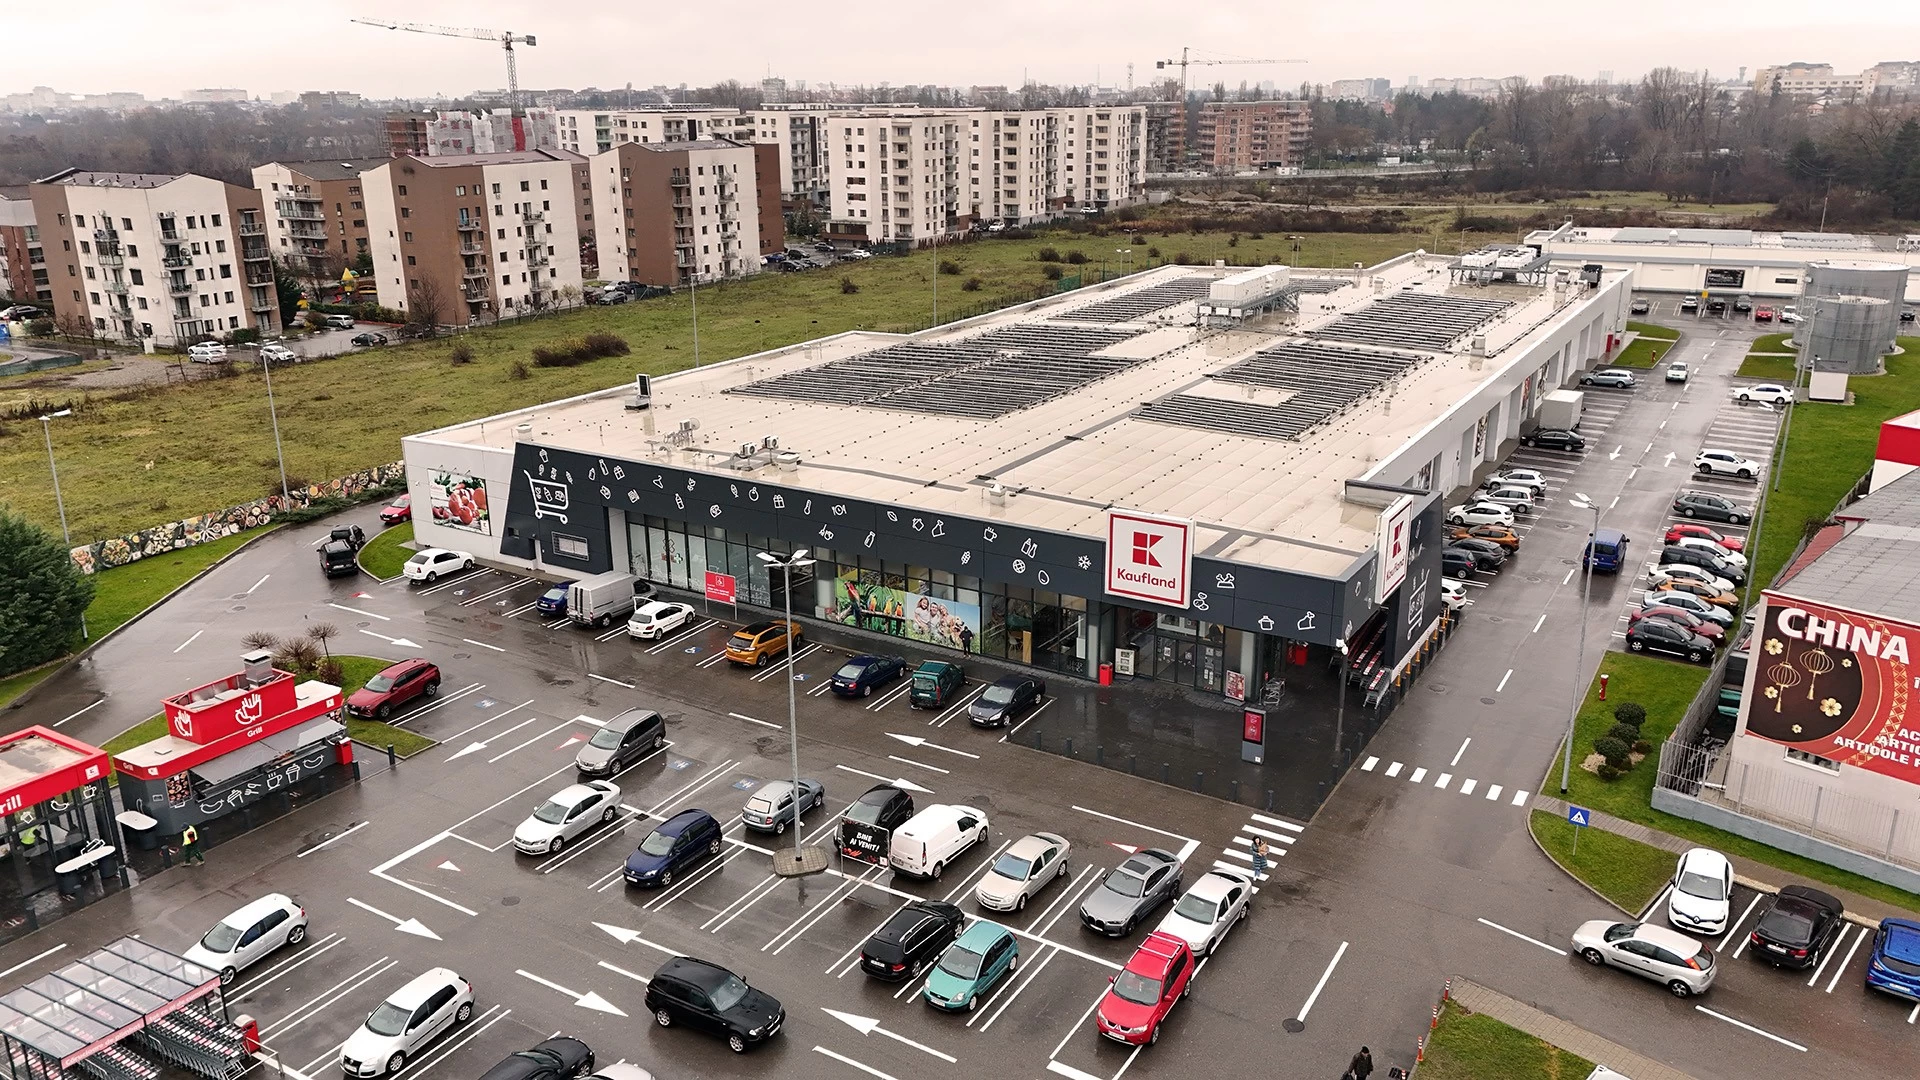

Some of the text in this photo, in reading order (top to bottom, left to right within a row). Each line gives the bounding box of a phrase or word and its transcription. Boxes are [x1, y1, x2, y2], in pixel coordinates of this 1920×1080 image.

[1117, 567, 1176, 589] Kaufland
[1777, 607, 1909, 665] CHINA
[247, 726, 262, 737] Grill
[856, 832, 873, 842] BINE
[858, 840, 880, 852] VENIT!
